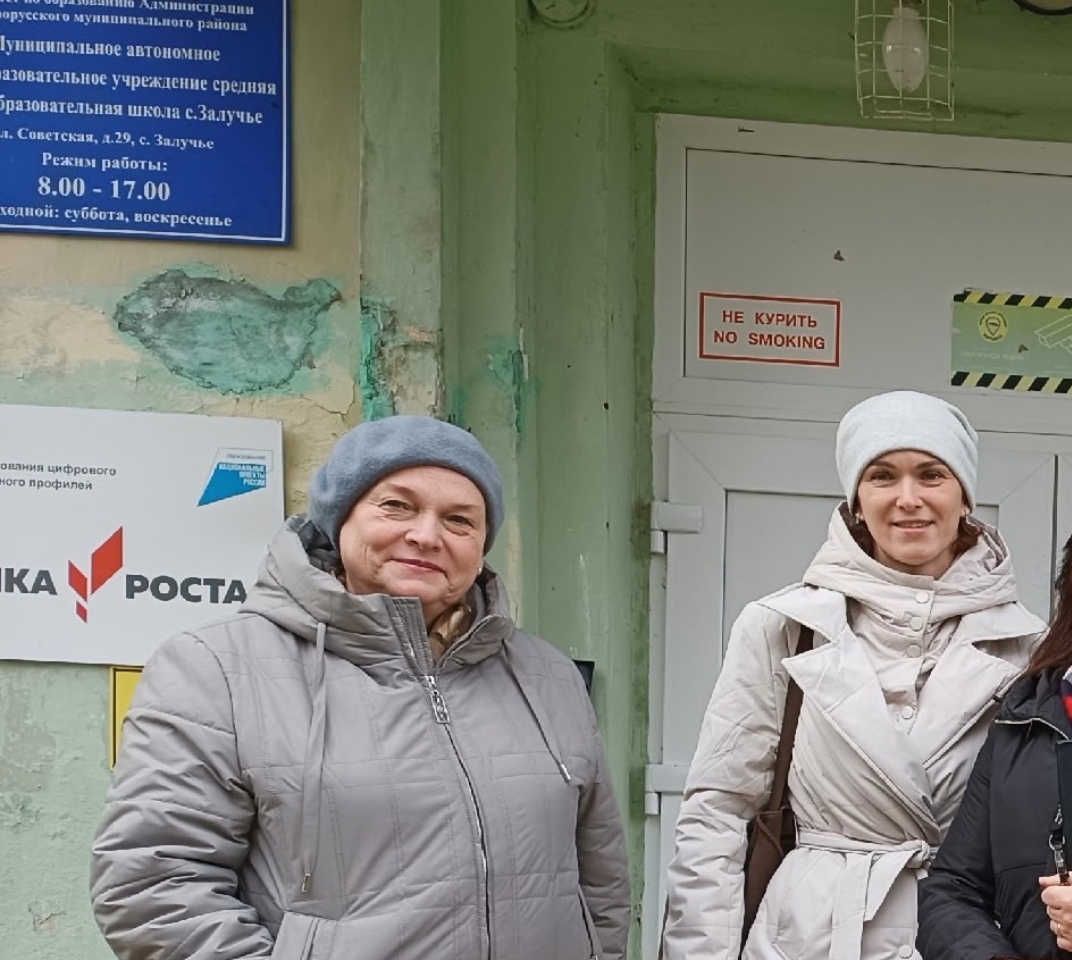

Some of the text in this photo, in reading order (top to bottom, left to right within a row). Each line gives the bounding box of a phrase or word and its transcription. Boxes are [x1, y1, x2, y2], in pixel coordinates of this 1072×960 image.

[0, 11, 248, 32] орусского муниципального района
[126, 44, 221, 62] автономное
[0, 69, 277, 97] азовательное учреждение средняя
[128, 104, 181, 120] школа
[185, 104, 264, 127] с.Залучье
[17, 127, 98, 145] Советская,
[102, 131, 135, 147] д.29,
[154, 134, 215, 151] Залучье
[42, 152, 168, 171] Режим работы:
[38, 176, 86, 197] 8.00
[110, 179, 171, 201] 17.00
[64, 207, 130, 223] суббота,
[134, 212, 233, 228] воскресенье
[722, 310, 818, 328] НЕ КУРИТЬ
[713, 330, 826, 350] NO SMOKING
[0, 463, 117, 476] ования цифрового
[29, 479, 93, 491] профилей
[0, 567, 248, 604] КА РОСТА
